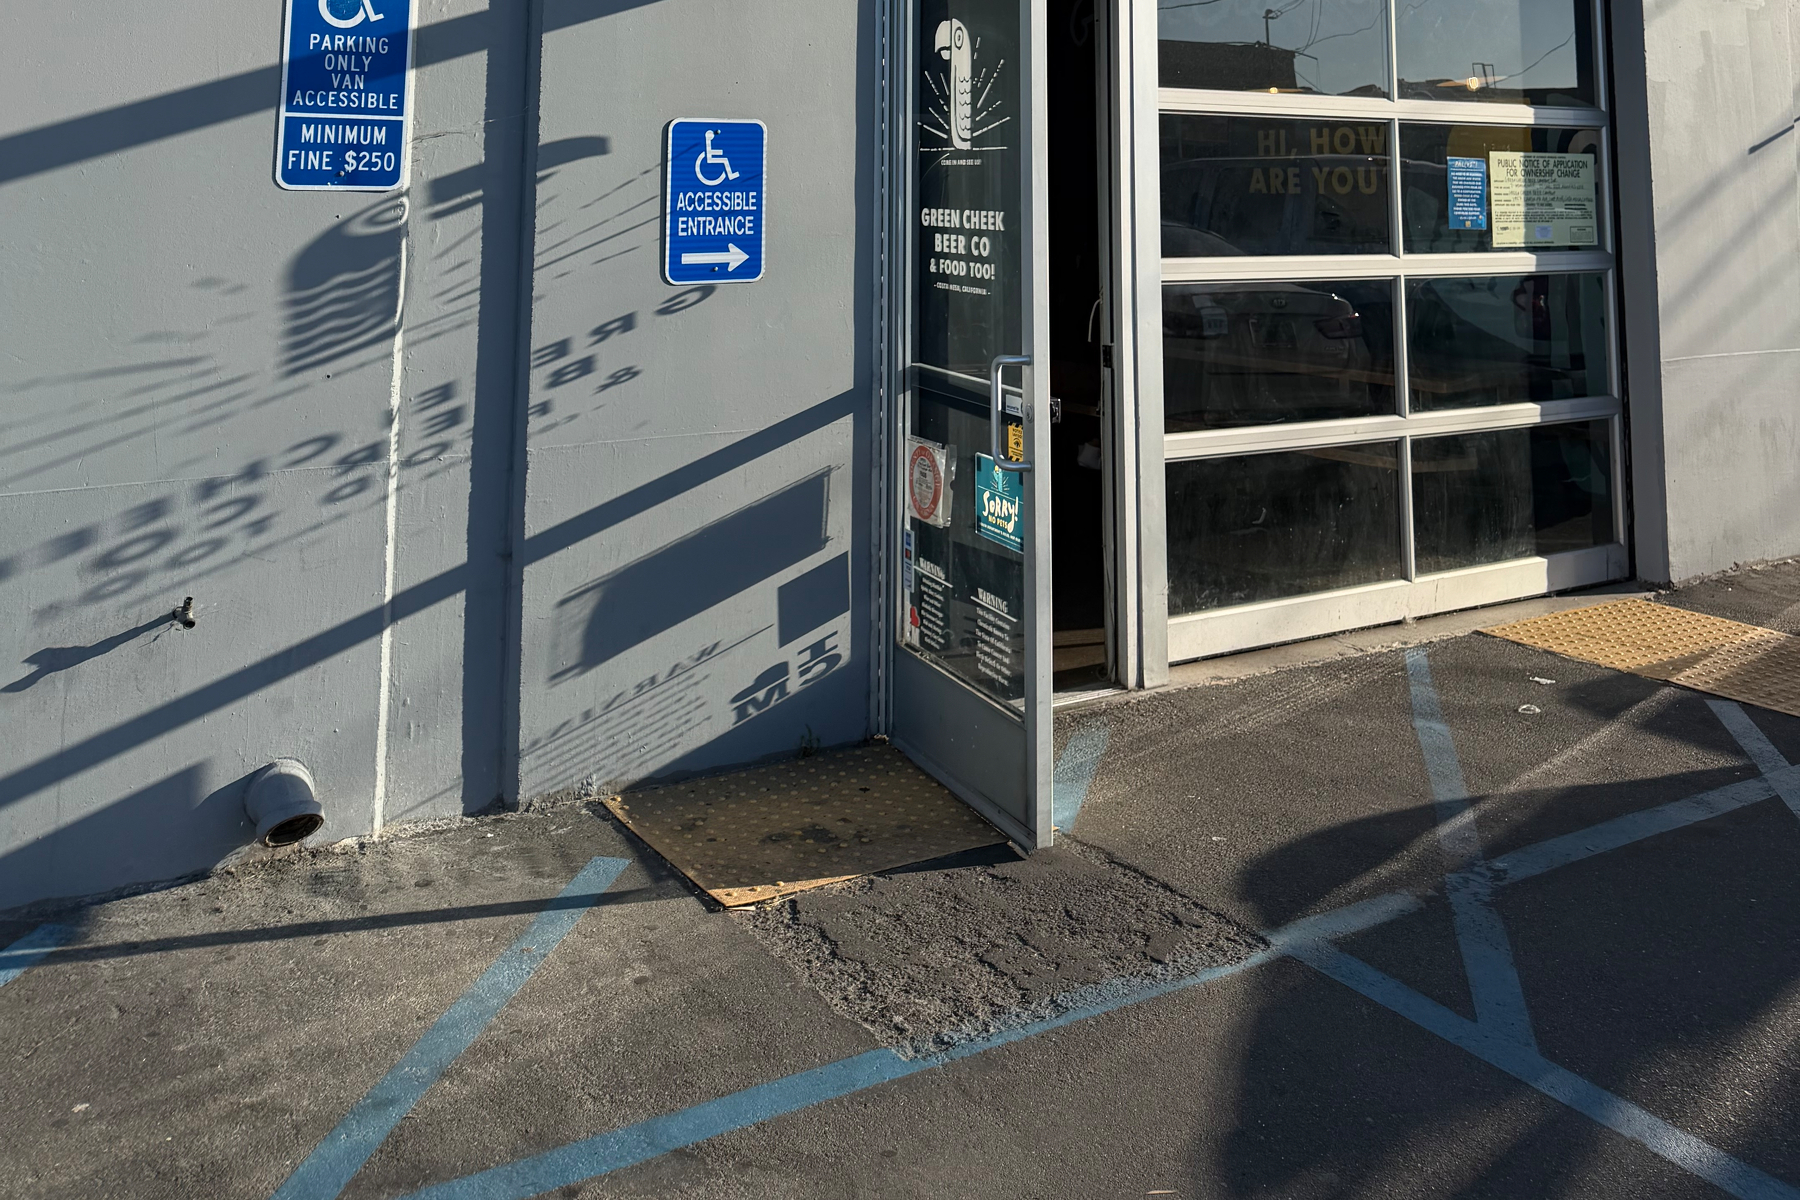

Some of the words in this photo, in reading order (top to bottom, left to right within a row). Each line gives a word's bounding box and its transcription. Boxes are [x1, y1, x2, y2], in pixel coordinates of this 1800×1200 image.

[309, 34, 389, 54] PARKING
[324, 53, 372, 72] ONLY
[331, 73, 364, 90] VAN
[293, 90, 398, 110] ACCESSIBLE
[301, 123, 386, 145] MINIMUM
[1310, 126, 1384, 154] HOW
[288, 150, 332, 171] FINE
[344, 149, 395, 174] $250
[1498, 159, 1516, 168] PUBLIC
[1520, 159, 1540, 168] NOTICE
[1542, 160, 1550, 168] OF
[1553, 160, 1588, 169] APPLICATION
[1249, 168, 1301, 194] ARE
[1506, 168, 1518, 177] FOR
[1520, 169, 1554, 177] OWNERSHIP
[1557, 170, 1580, 178] CHANGE
[677, 192, 757, 211] ACCESSIBLE
[678, 216, 754, 236] ENTRANCE
[921, 208, 960, 228] GREEN
[963, 210, 1005, 231] CHEEK
[934, 233, 966, 254] BEER
[970, 236, 991, 257] CO
[930, 258, 937, 272] &
[940, 259, 966, 276] FOOD
[969, 262, 995, 280] TOO!
[988, 514, 996, 524] NO
[997, 518, 1008, 529] PETS
